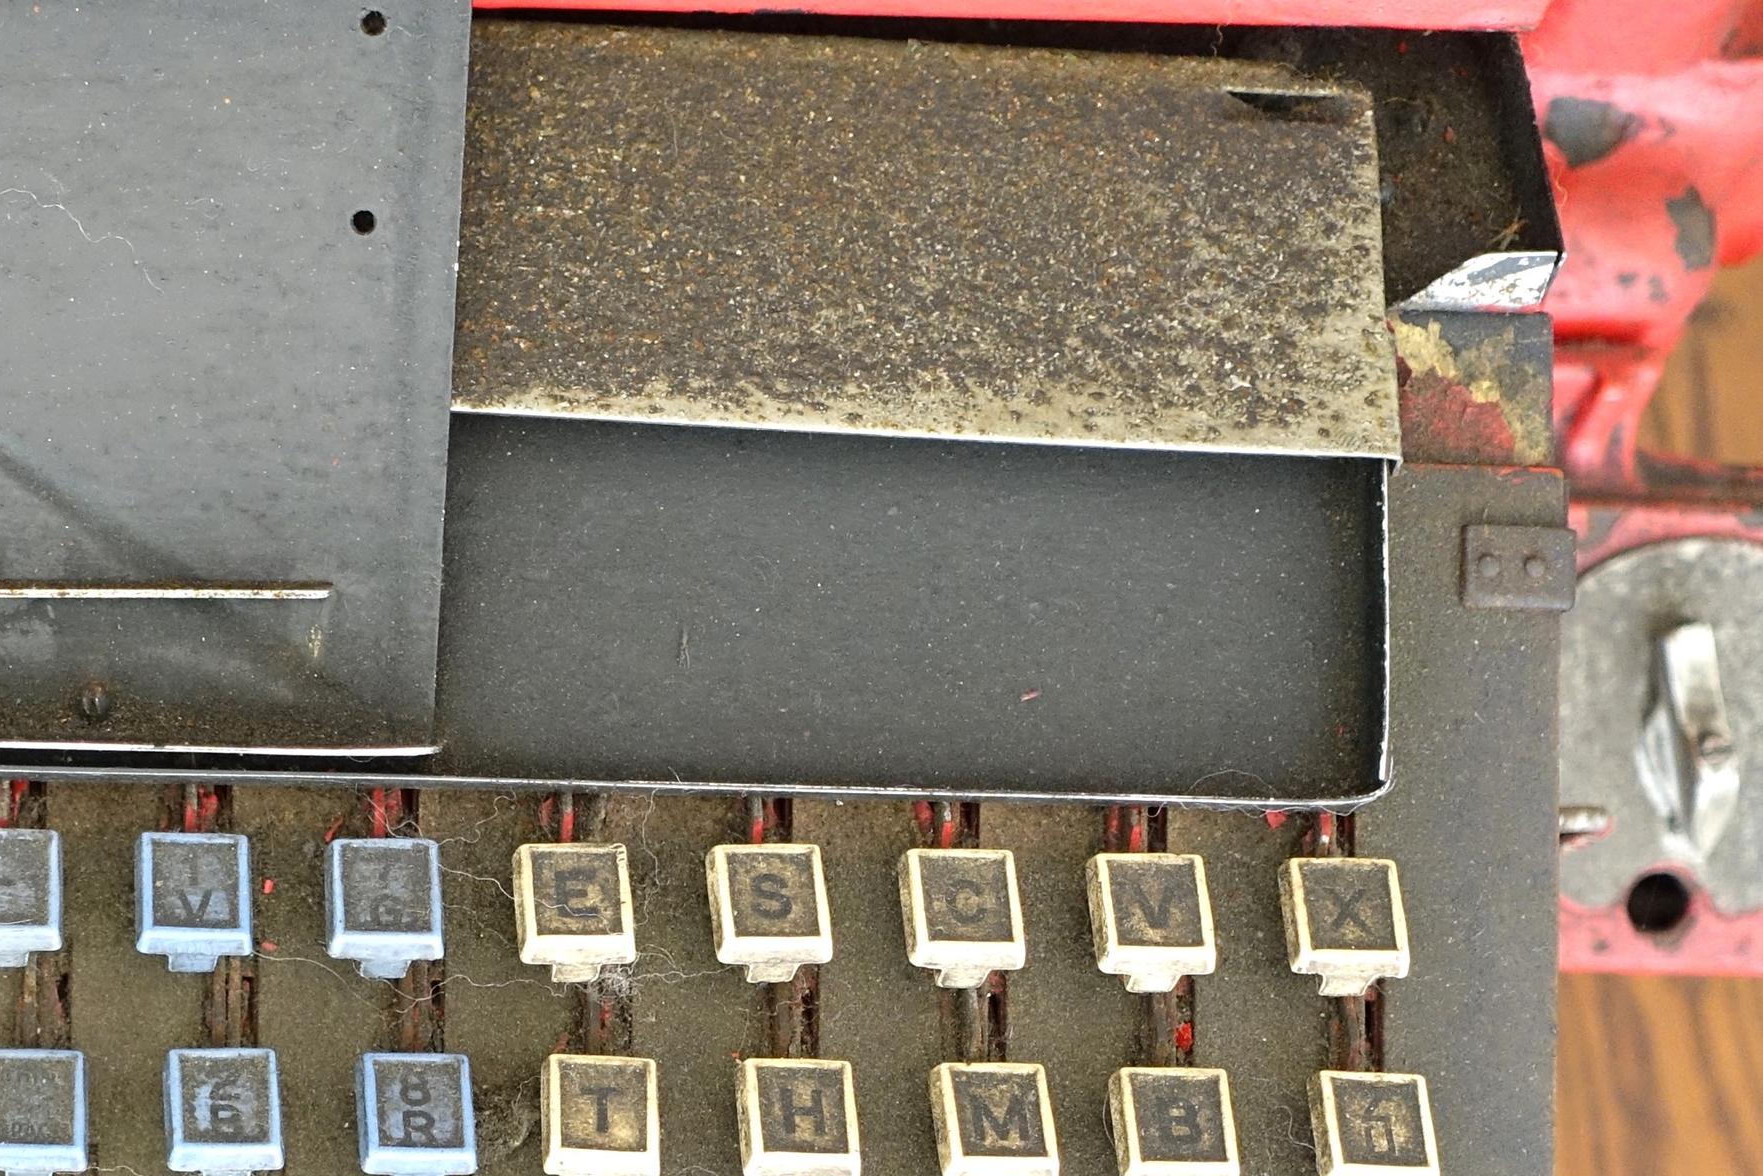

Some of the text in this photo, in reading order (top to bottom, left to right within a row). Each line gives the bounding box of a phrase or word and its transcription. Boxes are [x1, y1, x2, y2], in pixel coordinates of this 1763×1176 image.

[177, 888, 212, 921] V
[554, 869, 601, 918] E
[750, 874, 790, 920] S
[948, 880, 989, 924] C
[1130, 883, 1170, 929] V
[1330, 889, 1368, 936] X
[399, 1071, 431, 1106] 8
[583, 1086, 625, 1133] T
[401, 1109, 434, 1146] R
[781, 1089, 825, 1135] H
[970, 1098, 1032, 1142] M
[1160, 1097, 1201, 1145] B
